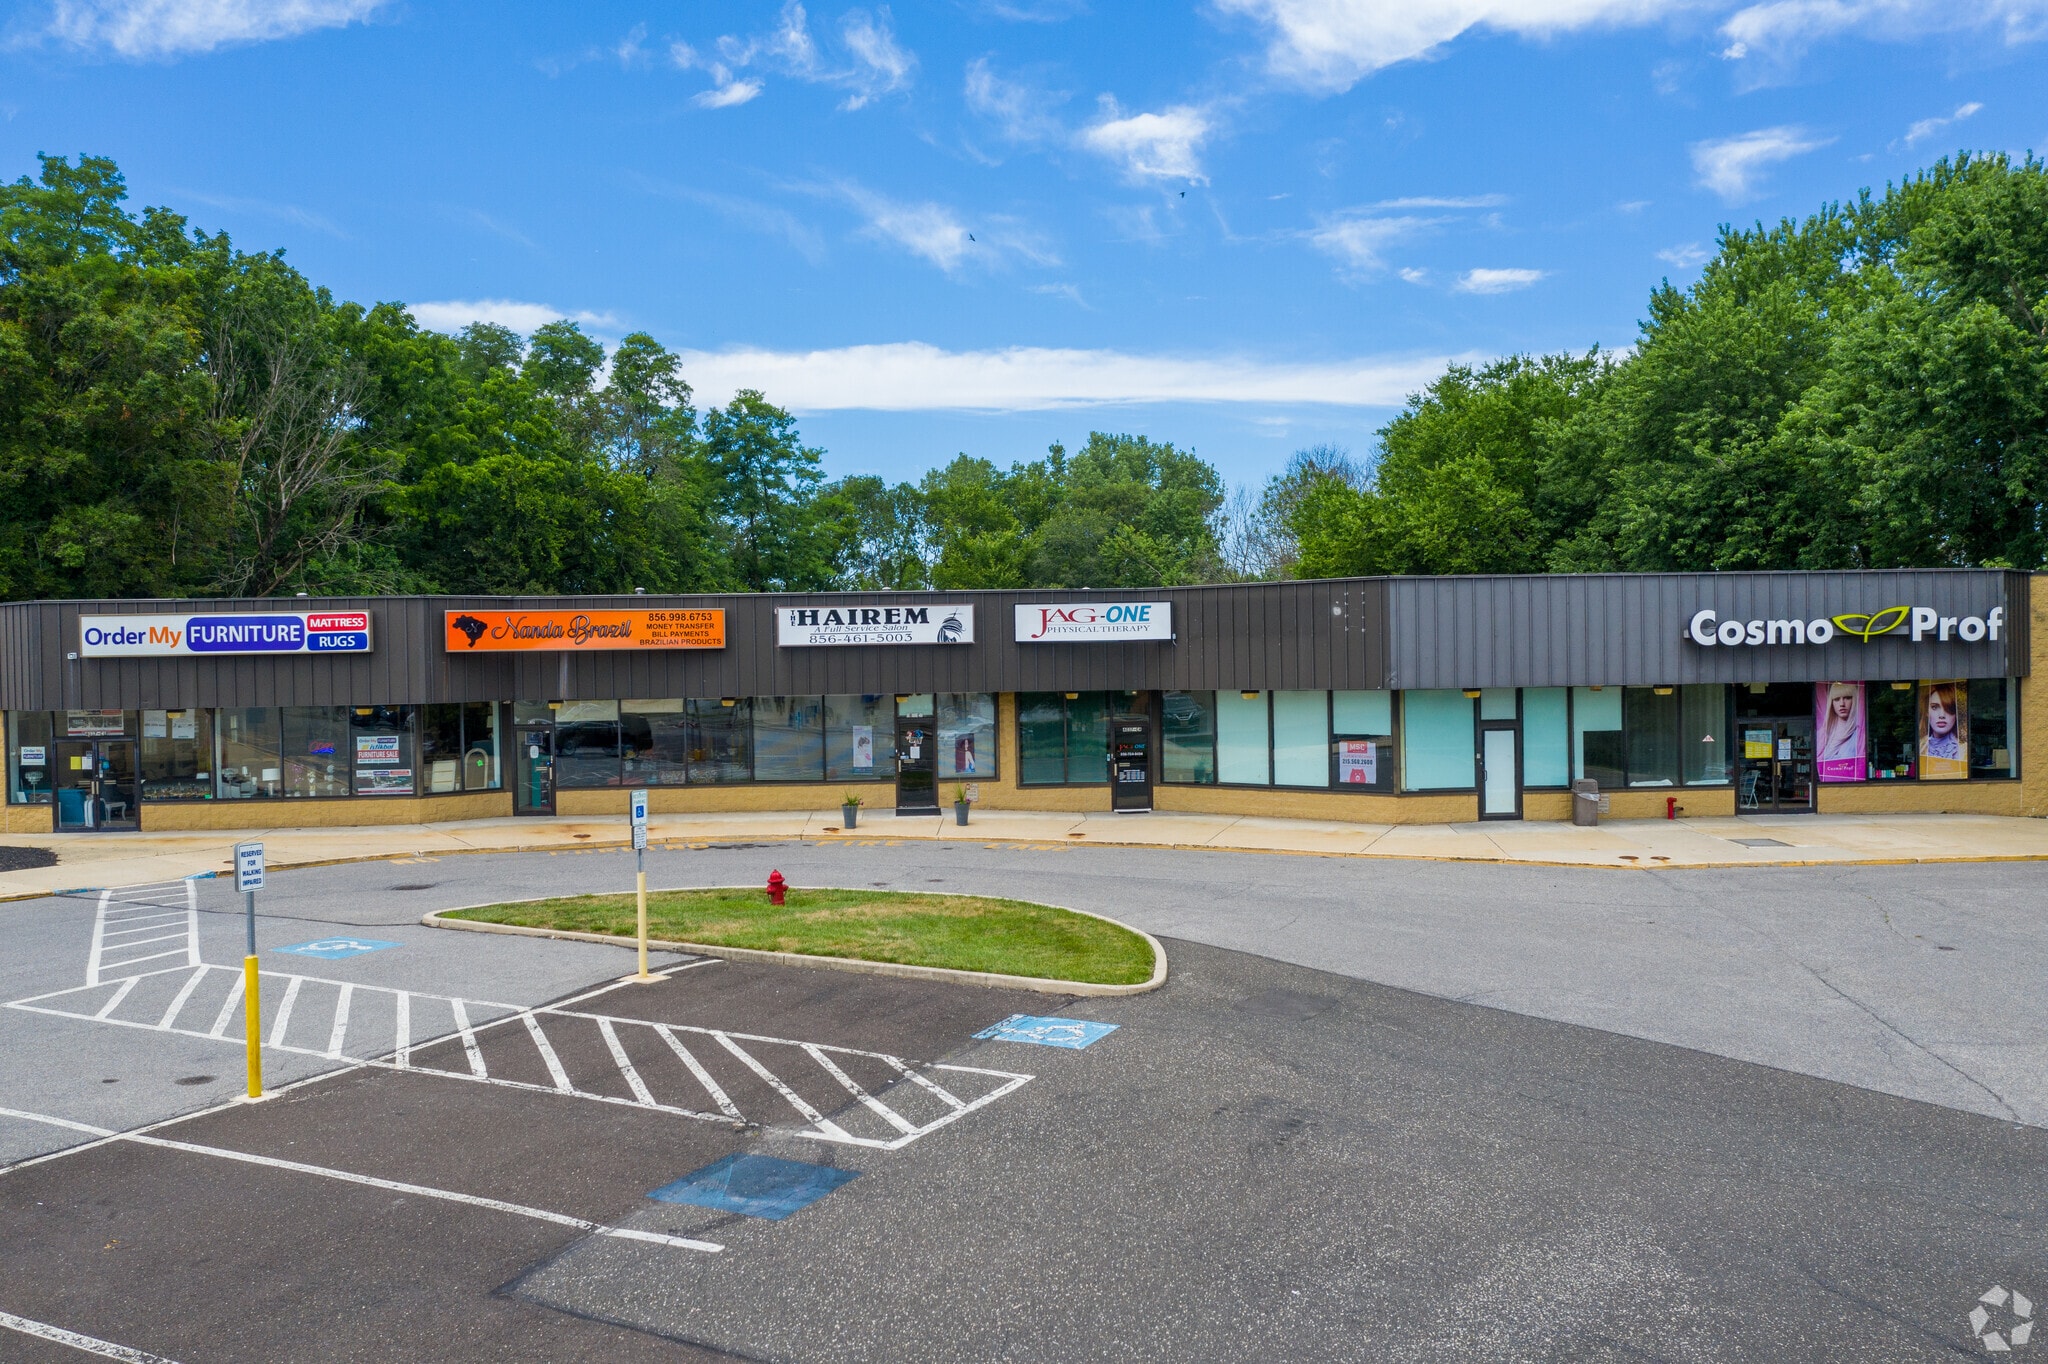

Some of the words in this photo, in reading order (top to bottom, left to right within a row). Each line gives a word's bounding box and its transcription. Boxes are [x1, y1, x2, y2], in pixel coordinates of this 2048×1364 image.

[648, 612, 713, 621] 856.998.6753
[797, 607, 930, 626] HAIREM
[1031, 605, 1152, 638] JAG-ONE
[310, 617, 364, 628] MATTRESS
[1690, 609, 1834, 646] Cosmo
[1910, 606, 2003, 642] Prof
[491, 616, 565, 639] Nanda
[567, 614, 632, 645] Brazil
[1047, 625, 1099, 633] PHYSICAL
[1100, 624, 1150, 633] THERAPY
[84, 626, 146, 646] Order
[149, 626, 182, 648] My
[190, 625, 301, 643] FURNITURE
[319, 635, 356, 647] RUGS
[809, 633, 913, 644] 856-461-5003
[386, 750, 399, 758] SALE
[240, 849, 262, 858] RESERVED
